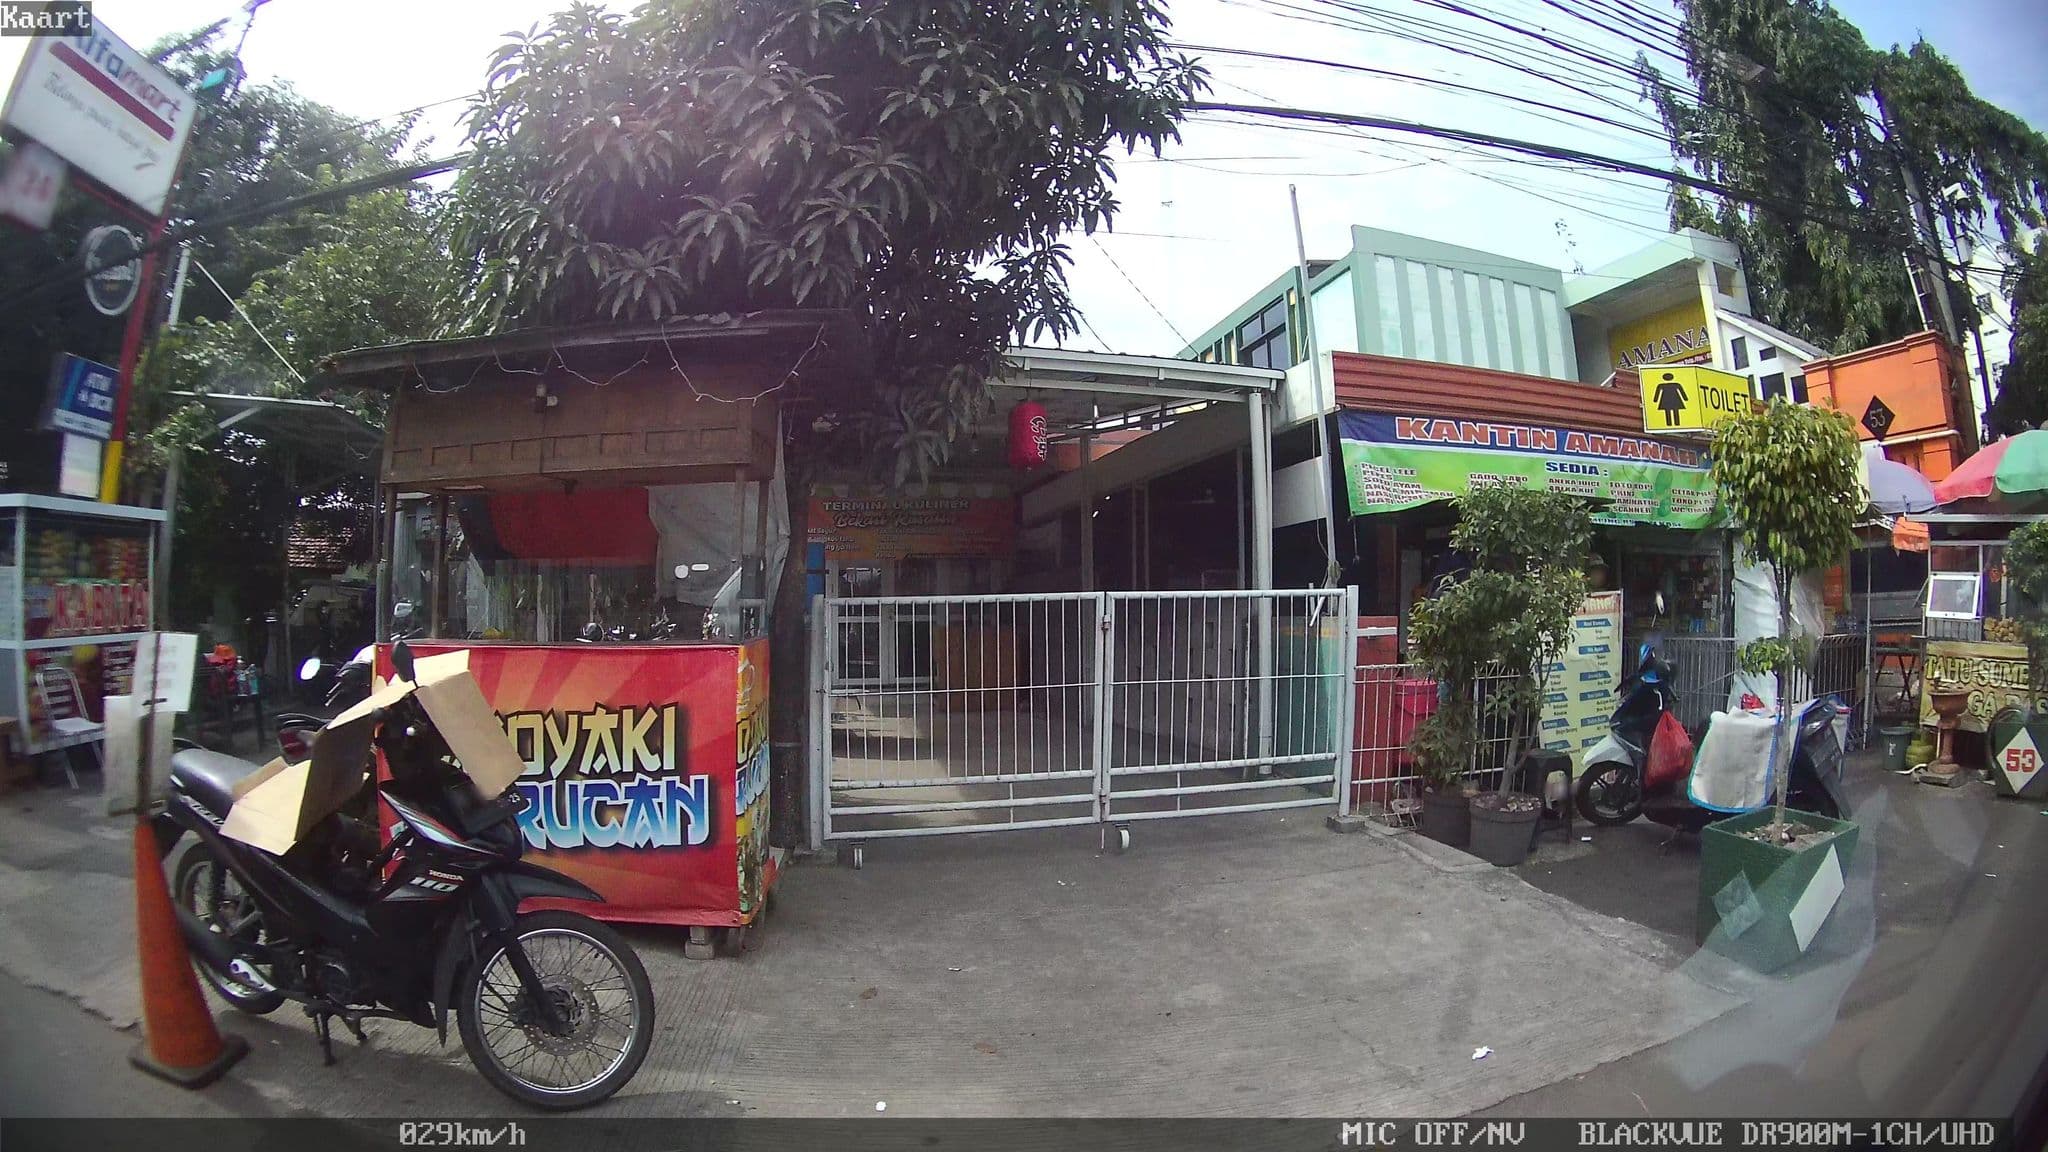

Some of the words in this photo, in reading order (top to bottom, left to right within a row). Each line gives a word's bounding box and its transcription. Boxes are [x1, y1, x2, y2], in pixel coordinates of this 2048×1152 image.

[75, 30, 182, 122] lfamart
[1700, 384, 1749, 413] TOILET
[1869, 408, 1886, 428] 53
[1395, 416, 1557, 450] KANTIN
[1564, 431, 1698, 468] AMANAH
[1545, 462, 1600, 476] SEDIA
[1393, 481, 1421, 489] AYAM
[1613, 505, 1651, 513] SCANNER
[1616, 498, 1659, 507] AMINATING
[1925, 654, 1972, 685] TAHU
[496, 703, 677, 777] OYAKI
[2006, 748, 2036, 773] 53
[410, 876, 460, 893] 110
[429, 869, 464, 881] HONDA
